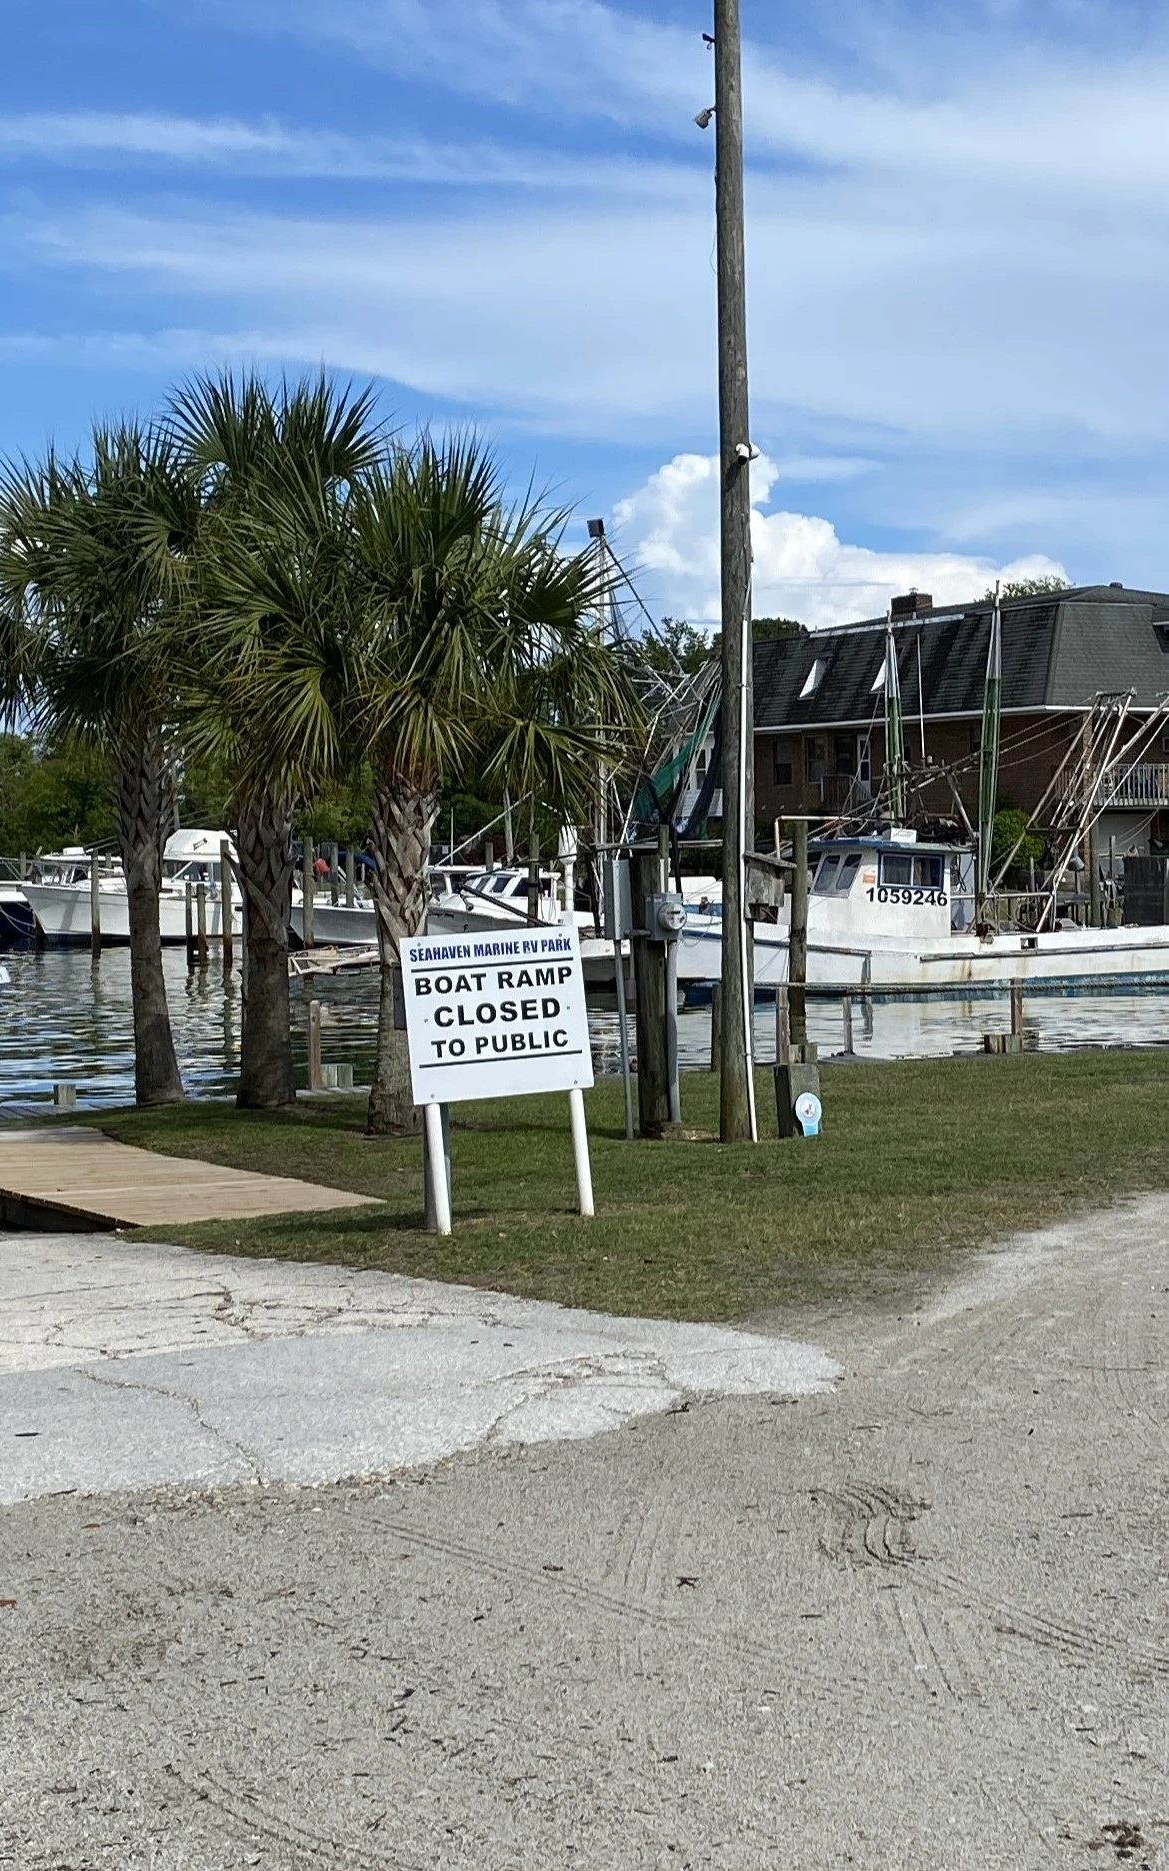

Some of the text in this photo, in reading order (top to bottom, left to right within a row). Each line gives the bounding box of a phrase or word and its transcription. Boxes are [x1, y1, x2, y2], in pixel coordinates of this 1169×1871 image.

[865, 887, 948, 907] 1059246
[409, 938, 572, 963] SEAHAVEN MARINE RV PARK
[414, 966, 573, 997] BOAT RAMP
[433, 997, 561, 1028] CLOSED
[430, 1029, 569, 1059] TO PUBLIC
